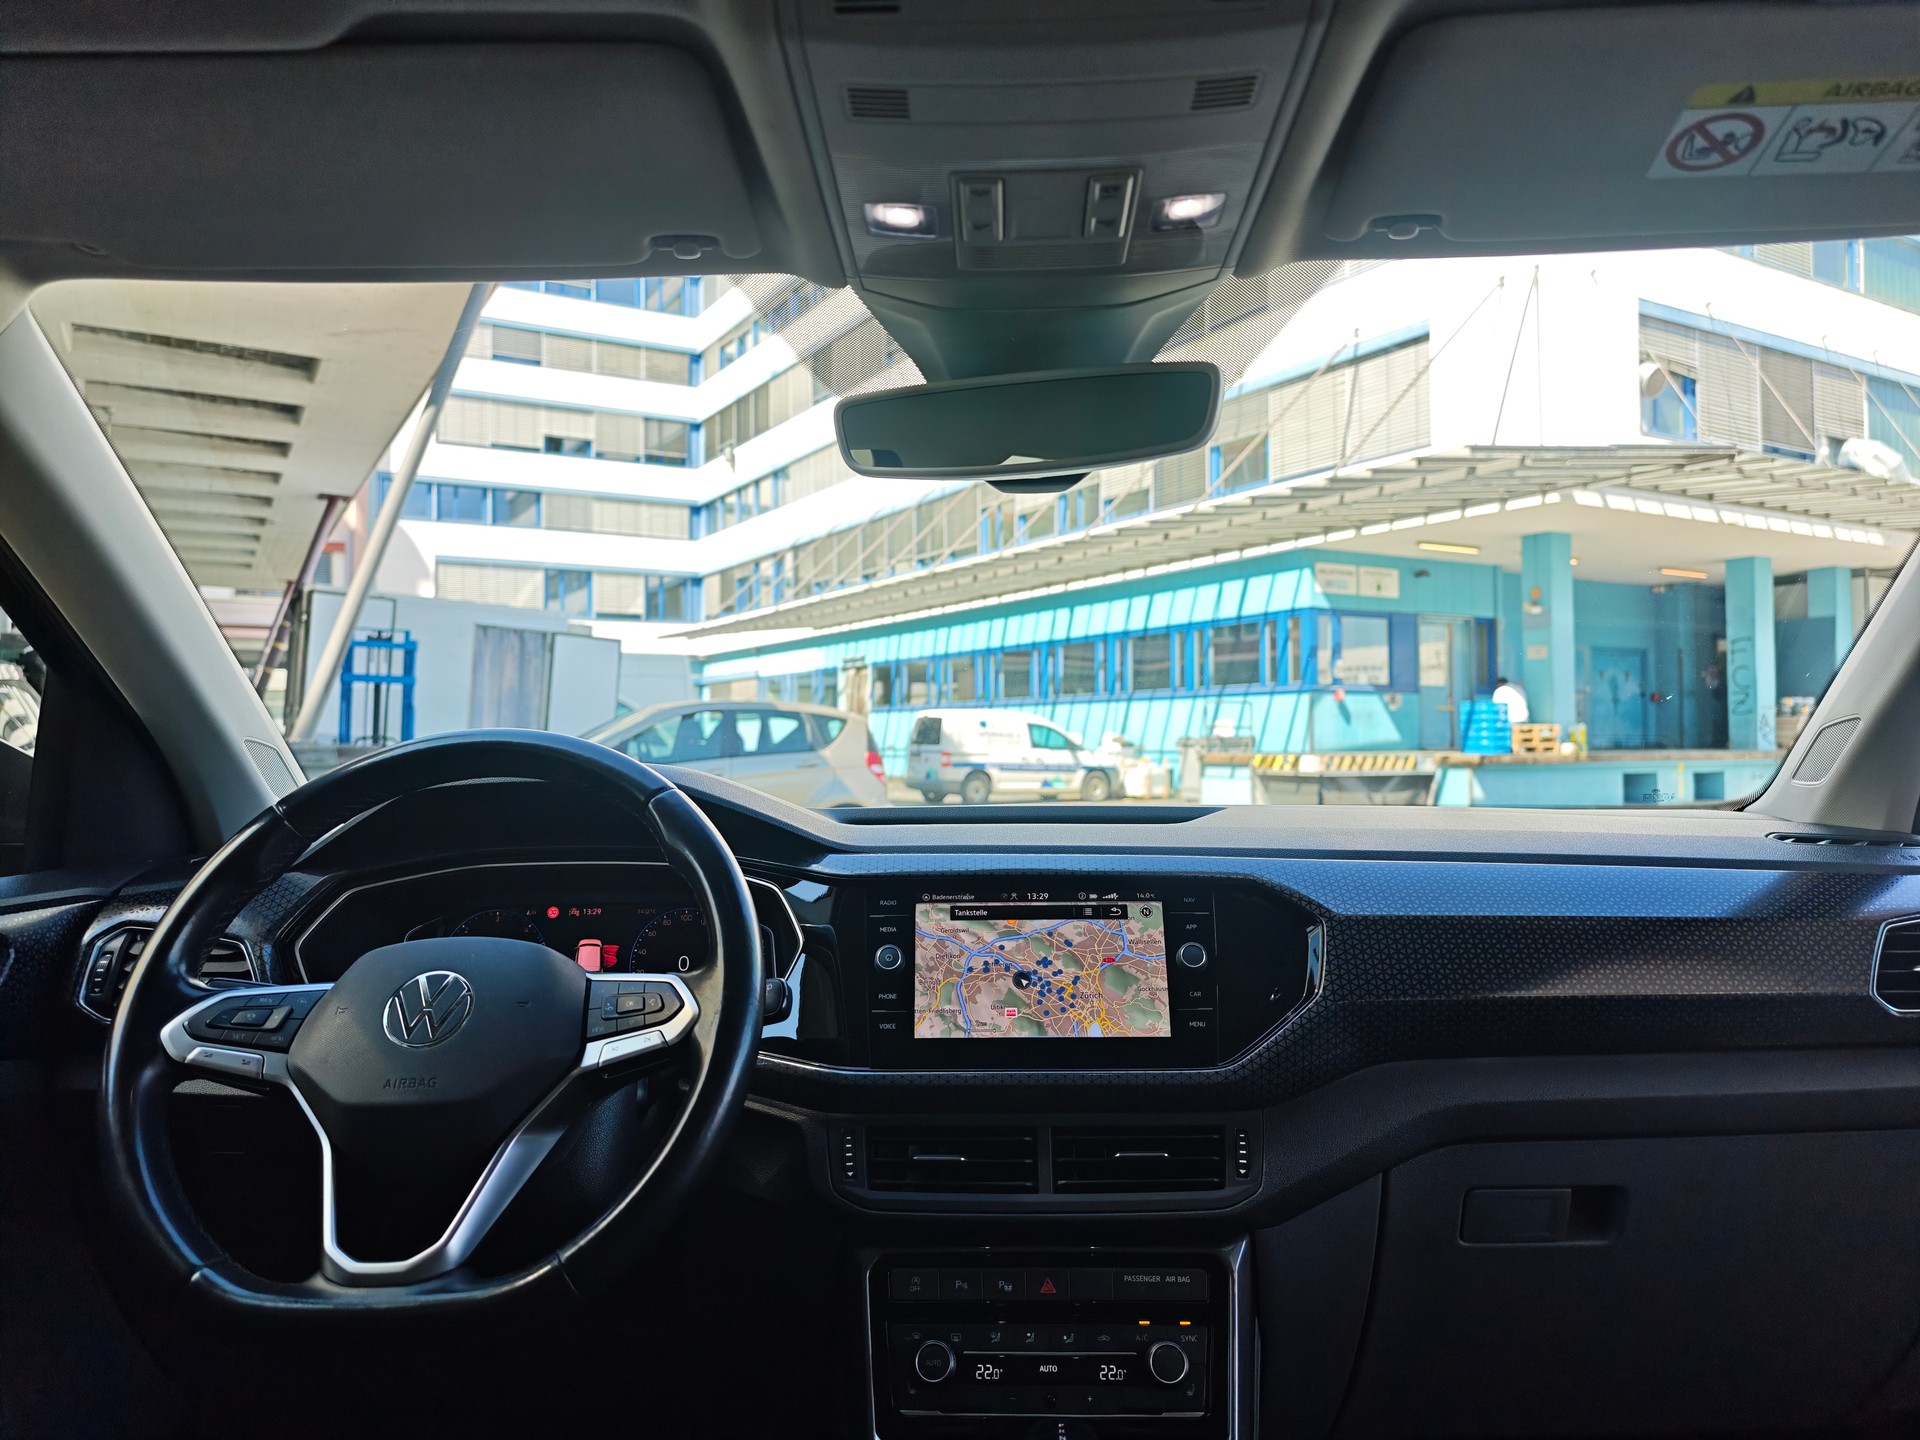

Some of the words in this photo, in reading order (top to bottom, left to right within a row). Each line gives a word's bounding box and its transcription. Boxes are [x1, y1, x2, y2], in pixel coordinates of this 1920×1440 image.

[1027, 892, 1049, 900] 13:29
[583, 907, 602, 916] 13:29
[955, 909, 988, 917] Tankstelle
[680, 914, 693, 922] 100
[678, 955, 690, 972] 0
[383, 1077, 438, 1090] AIRBAG
[1180, 1334, 1198, 1342] SYNC
[1039, 1365, 1058, 1373] AUTO
